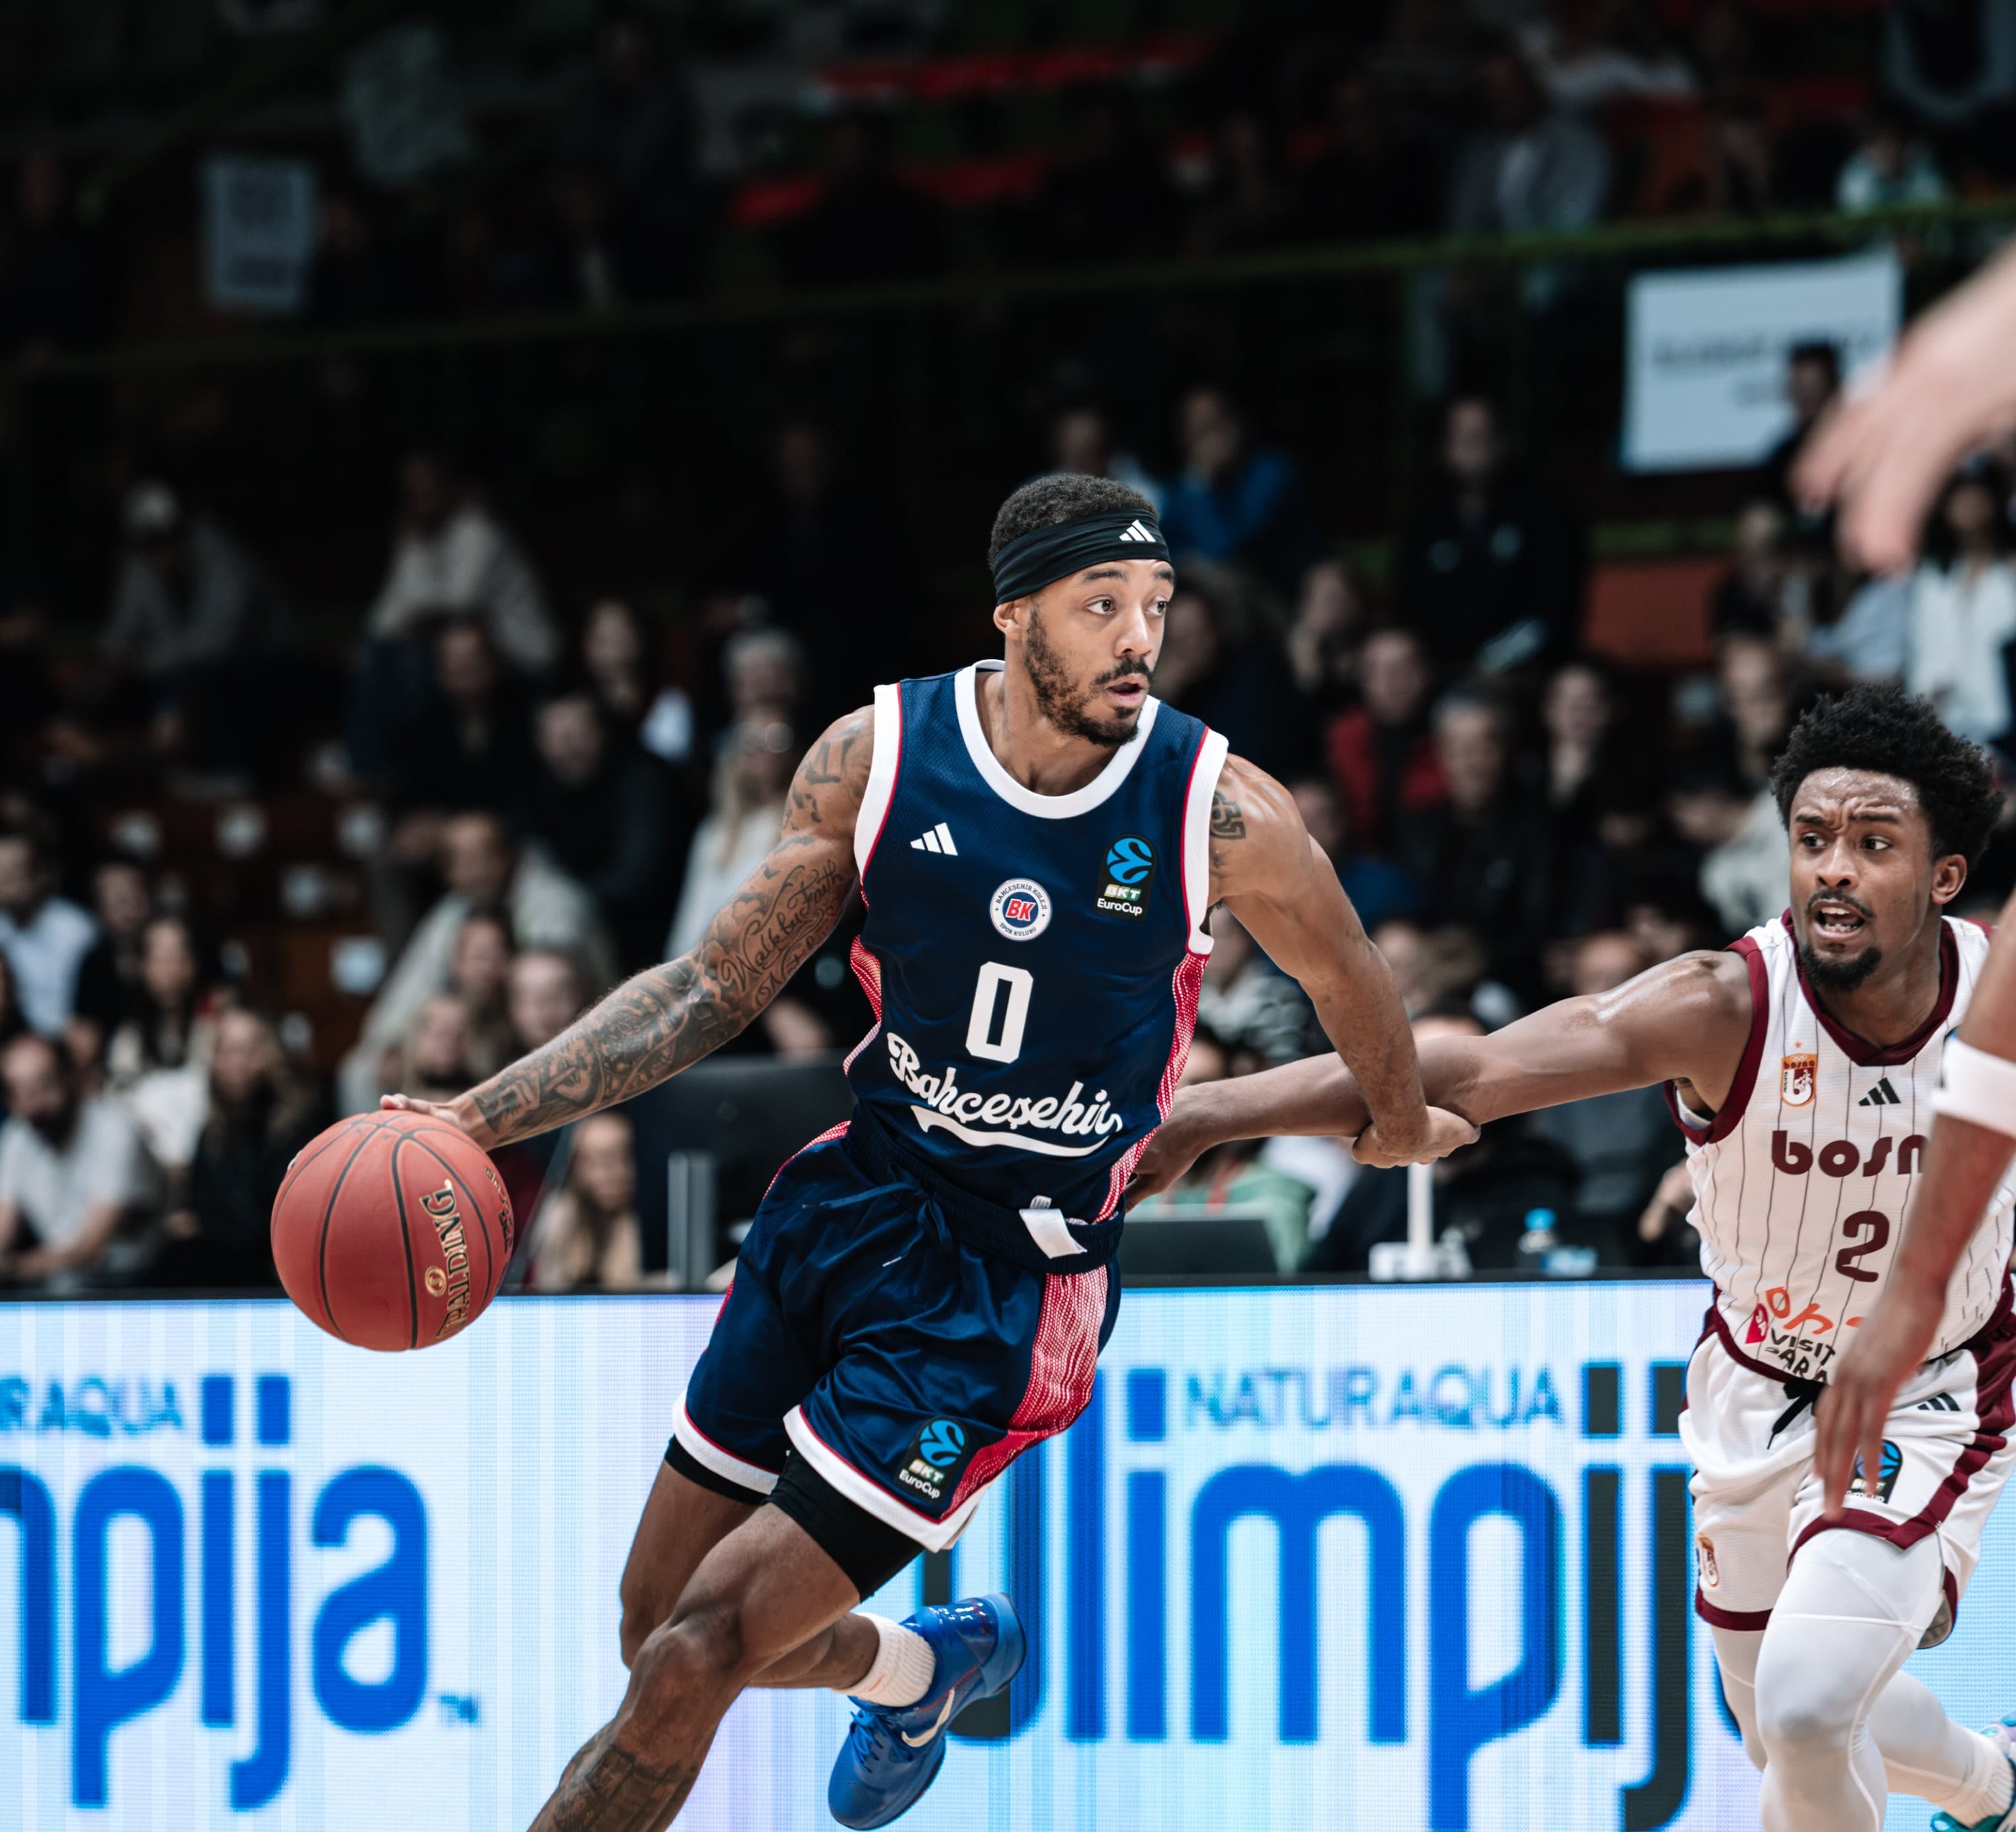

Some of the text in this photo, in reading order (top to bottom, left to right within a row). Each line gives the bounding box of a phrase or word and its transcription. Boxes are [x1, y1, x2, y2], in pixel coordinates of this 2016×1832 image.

[1006, 898, 1036, 921] BK
[1097, 898, 1143, 916] EuroCup
[1104, 884, 1142, 900] BKT
[965, 961, 1034, 1063] 0
[887, 1032, 1123, 1135] Bahçeşehir
[1772, 1130, 1930, 1178] bosn
[1835, 1210, 1890, 1282] 2
[1771, 1327, 1836, 1366] VISIT
[1187, 1362, 1564, 1430] NATURAQUA
[898, 1469, 940, 1499] EuroCup
